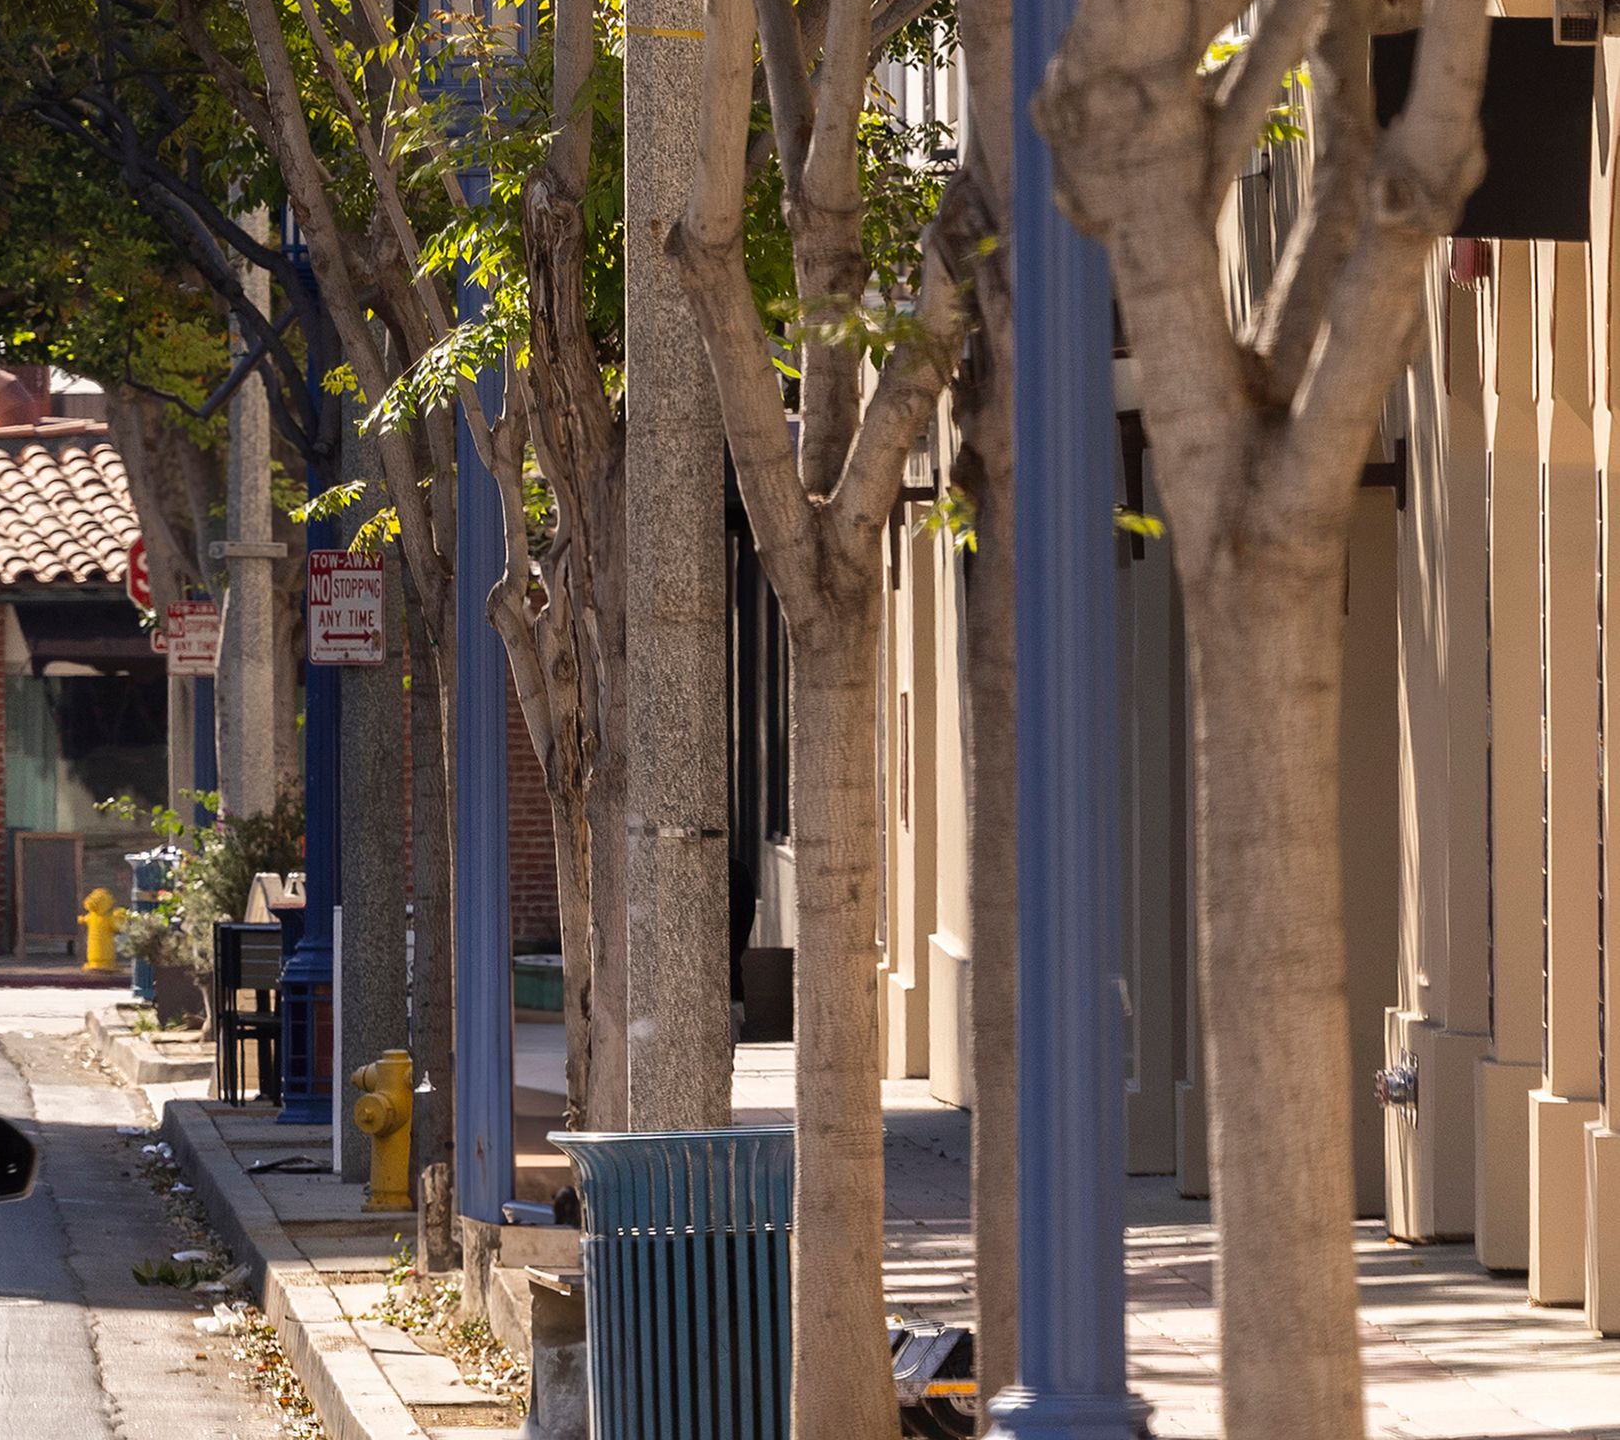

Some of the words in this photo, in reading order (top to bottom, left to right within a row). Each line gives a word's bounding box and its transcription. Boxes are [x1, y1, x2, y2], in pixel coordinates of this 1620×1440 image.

[311, 554, 381, 569] TOW-AWAY
[311, 574, 331, 603] NO
[333, 578, 381, 599] STOPPING
[318, 610, 342, 627] ANY
[348, 610, 375, 627] TIME
